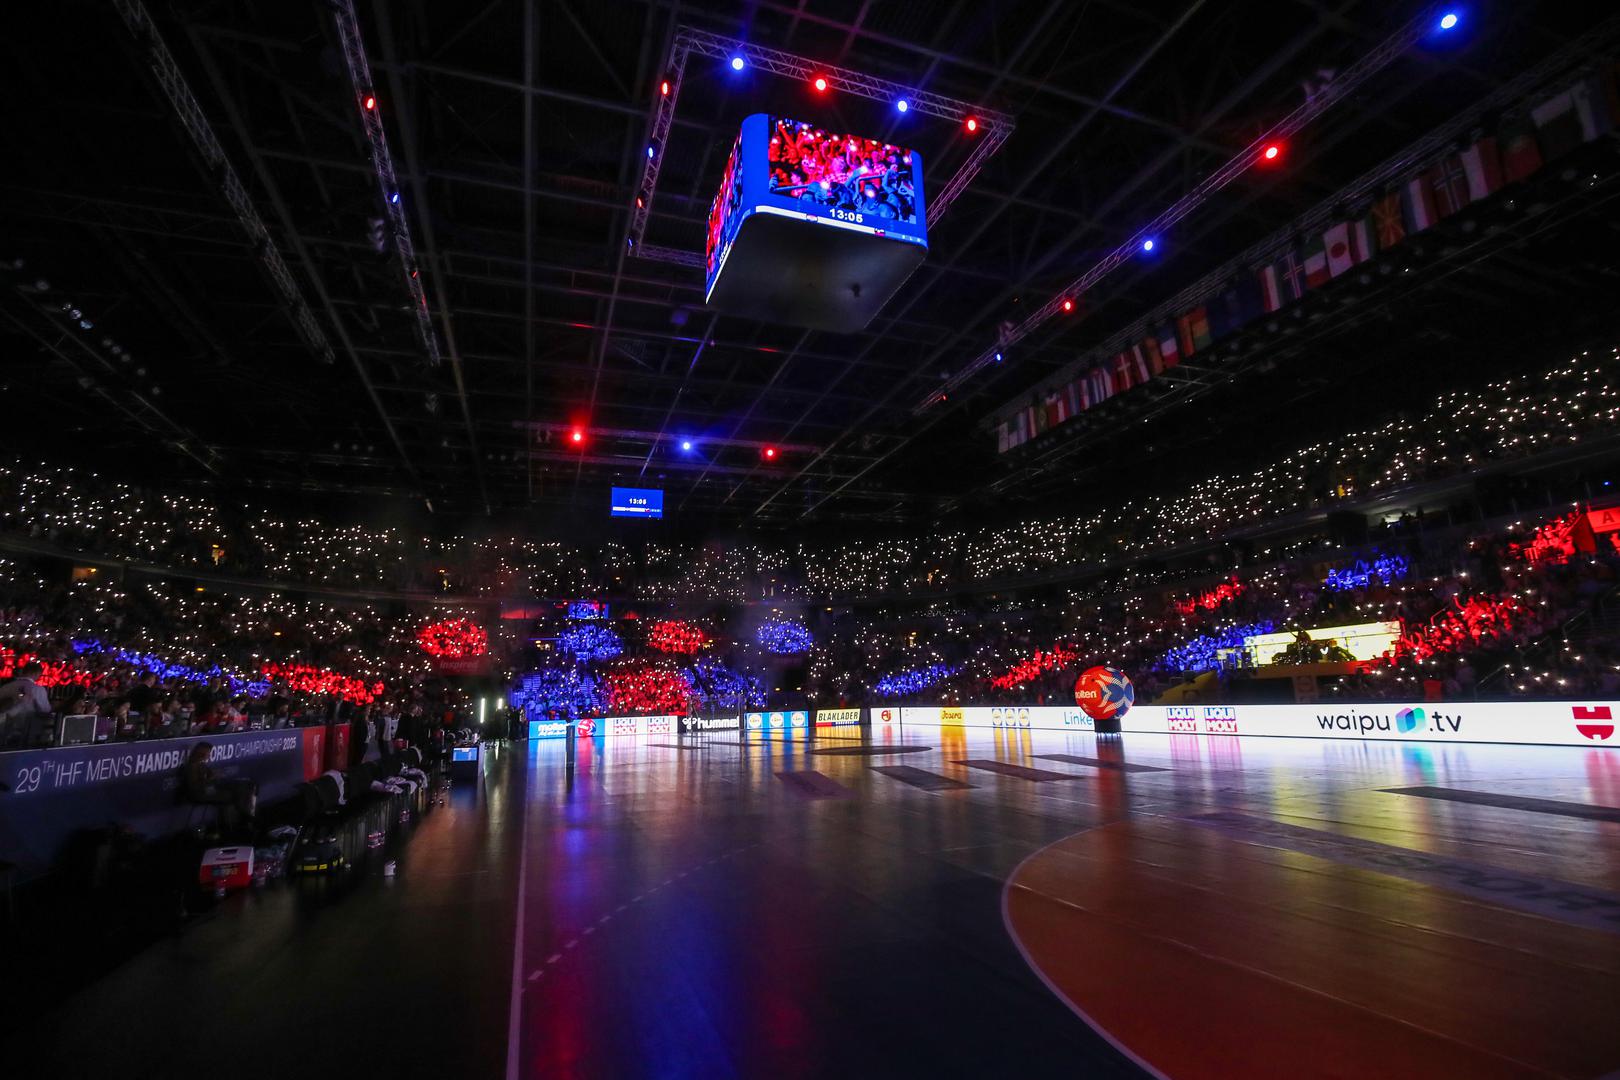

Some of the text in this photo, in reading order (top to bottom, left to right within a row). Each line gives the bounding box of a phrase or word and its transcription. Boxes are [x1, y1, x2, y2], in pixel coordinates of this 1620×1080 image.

[829, 208, 864, 223] 13:05
[1602, 511, 1616, 524] A
[698, 715, 740, 729] hummel
[1064, 711, 1093, 726] Linke
[1316, 709, 1462, 735] waipu .tv
[55, 761, 85, 788] IHF
[86, 755, 133, 782] MEN'S
[135, 749, 190, 775] HANDBA
[205, 743, 234, 763] ORLD
[234, 738, 283, 760] CHAMPIONSHIP
[282, 736, 297, 751] 2025
